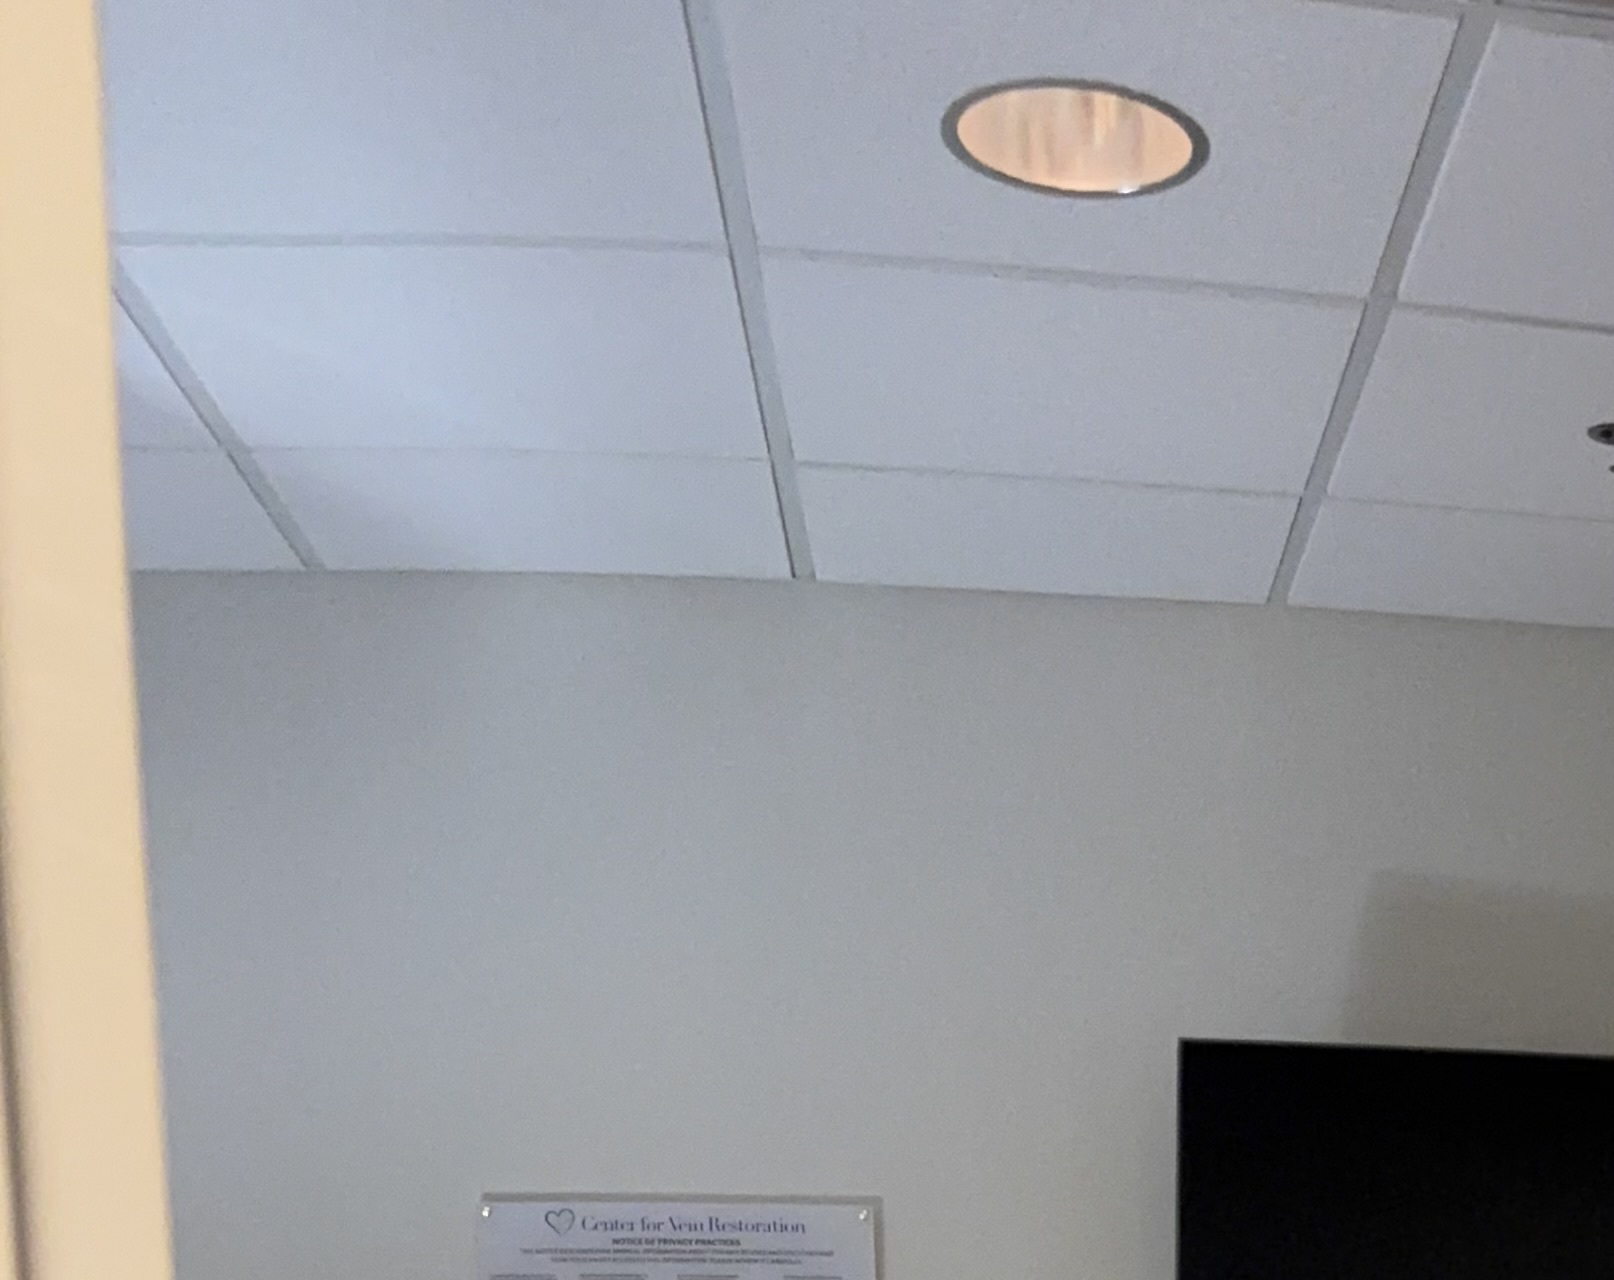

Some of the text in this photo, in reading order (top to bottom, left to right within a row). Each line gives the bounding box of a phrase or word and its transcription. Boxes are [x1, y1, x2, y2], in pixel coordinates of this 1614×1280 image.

[581, 1215, 806, 1234] Center for Vein Restoration
[658, 1238, 693, 1246] PRIVACY
